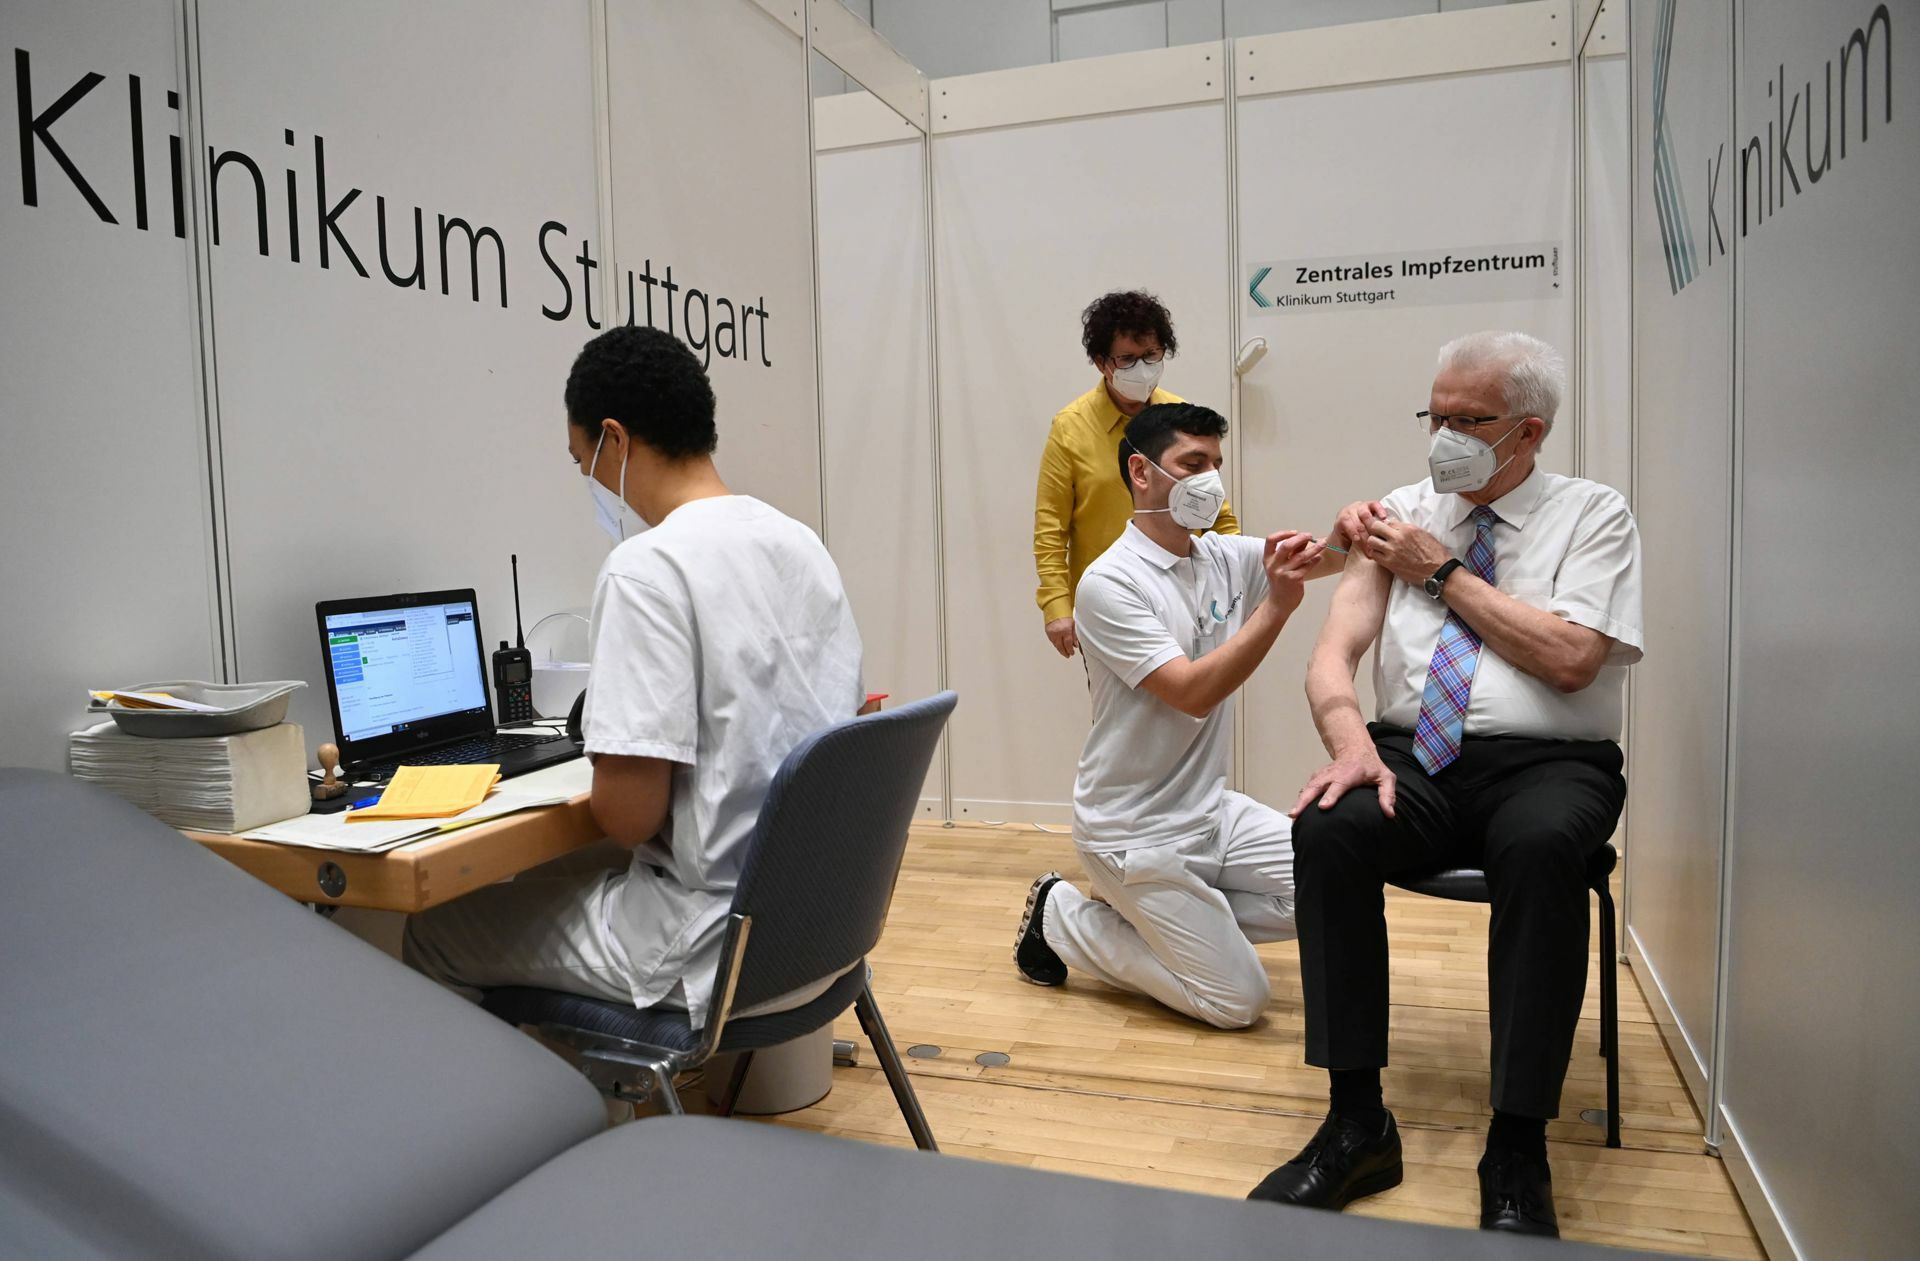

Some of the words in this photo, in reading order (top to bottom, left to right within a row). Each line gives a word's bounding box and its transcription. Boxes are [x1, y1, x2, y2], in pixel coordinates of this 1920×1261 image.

[14, 47, 508, 308] Klinikum
[538, 220, 772, 373] Stuttgart
[1295, 261, 1394, 284] Zentrales
[1401, 254, 1546, 280] Impfzentrum
[1276, 293, 1332, 308] Klinikum
[1335, 289, 1396, 305] Stuttgart
